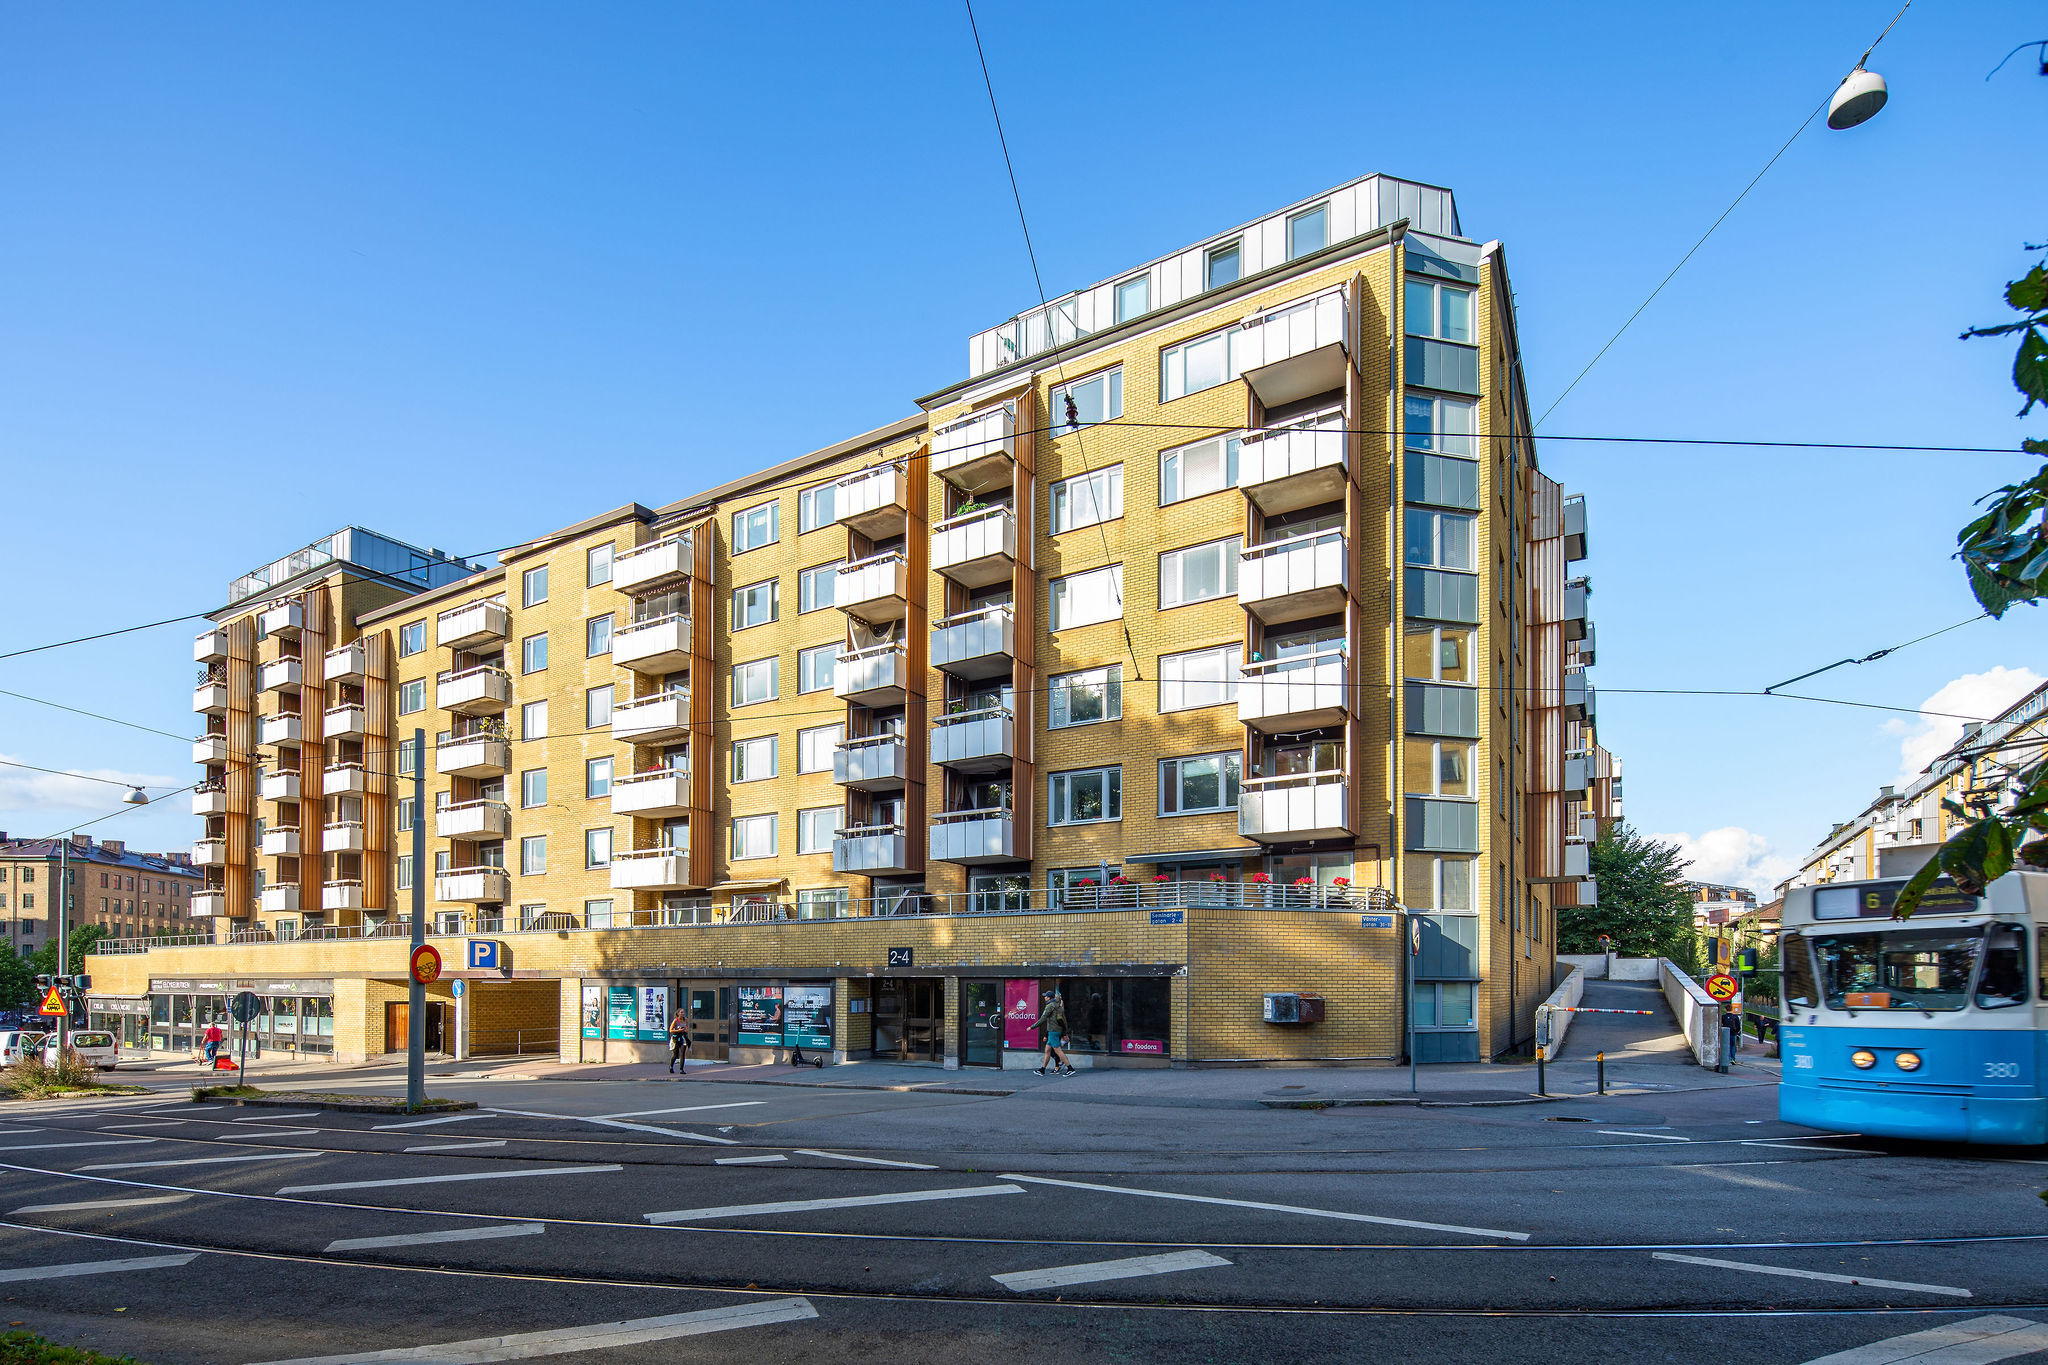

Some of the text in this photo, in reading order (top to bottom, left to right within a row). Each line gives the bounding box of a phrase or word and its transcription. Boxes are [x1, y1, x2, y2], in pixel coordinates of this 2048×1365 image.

[1866, 893, 1880, 909] 6
[475, 943, 491, 966] P
[890, 950, 910, 964] 2-4
[1008, 1011, 1036, 1020] foodora
[1983, 1062, 2020, 1078] 380
